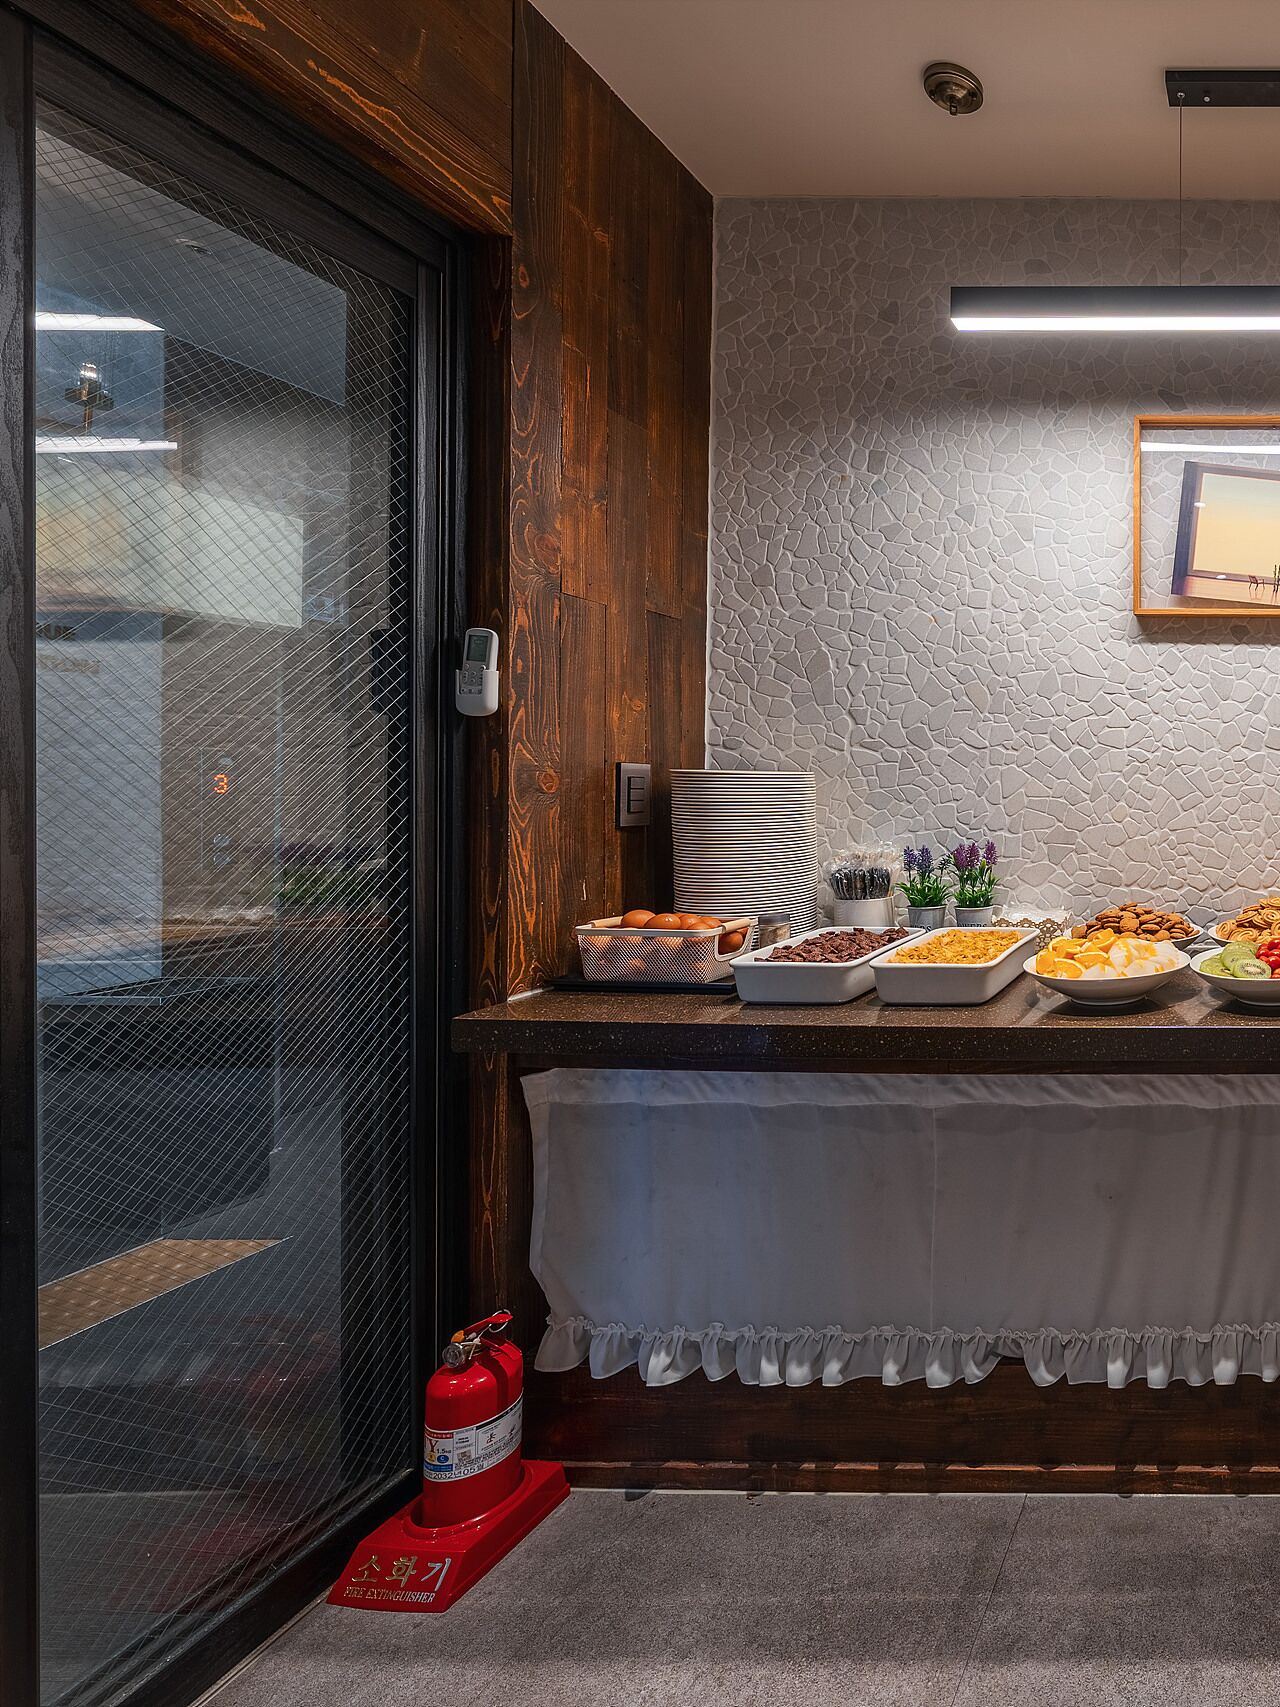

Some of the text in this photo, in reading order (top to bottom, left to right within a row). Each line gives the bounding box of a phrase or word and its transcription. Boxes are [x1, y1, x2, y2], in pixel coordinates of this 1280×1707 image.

[214, 773, 228, 795] 3
[351, 1554, 452, 1591] 소화기
[343, 1586, 436, 1603] FIRE EXTINGUISHER
